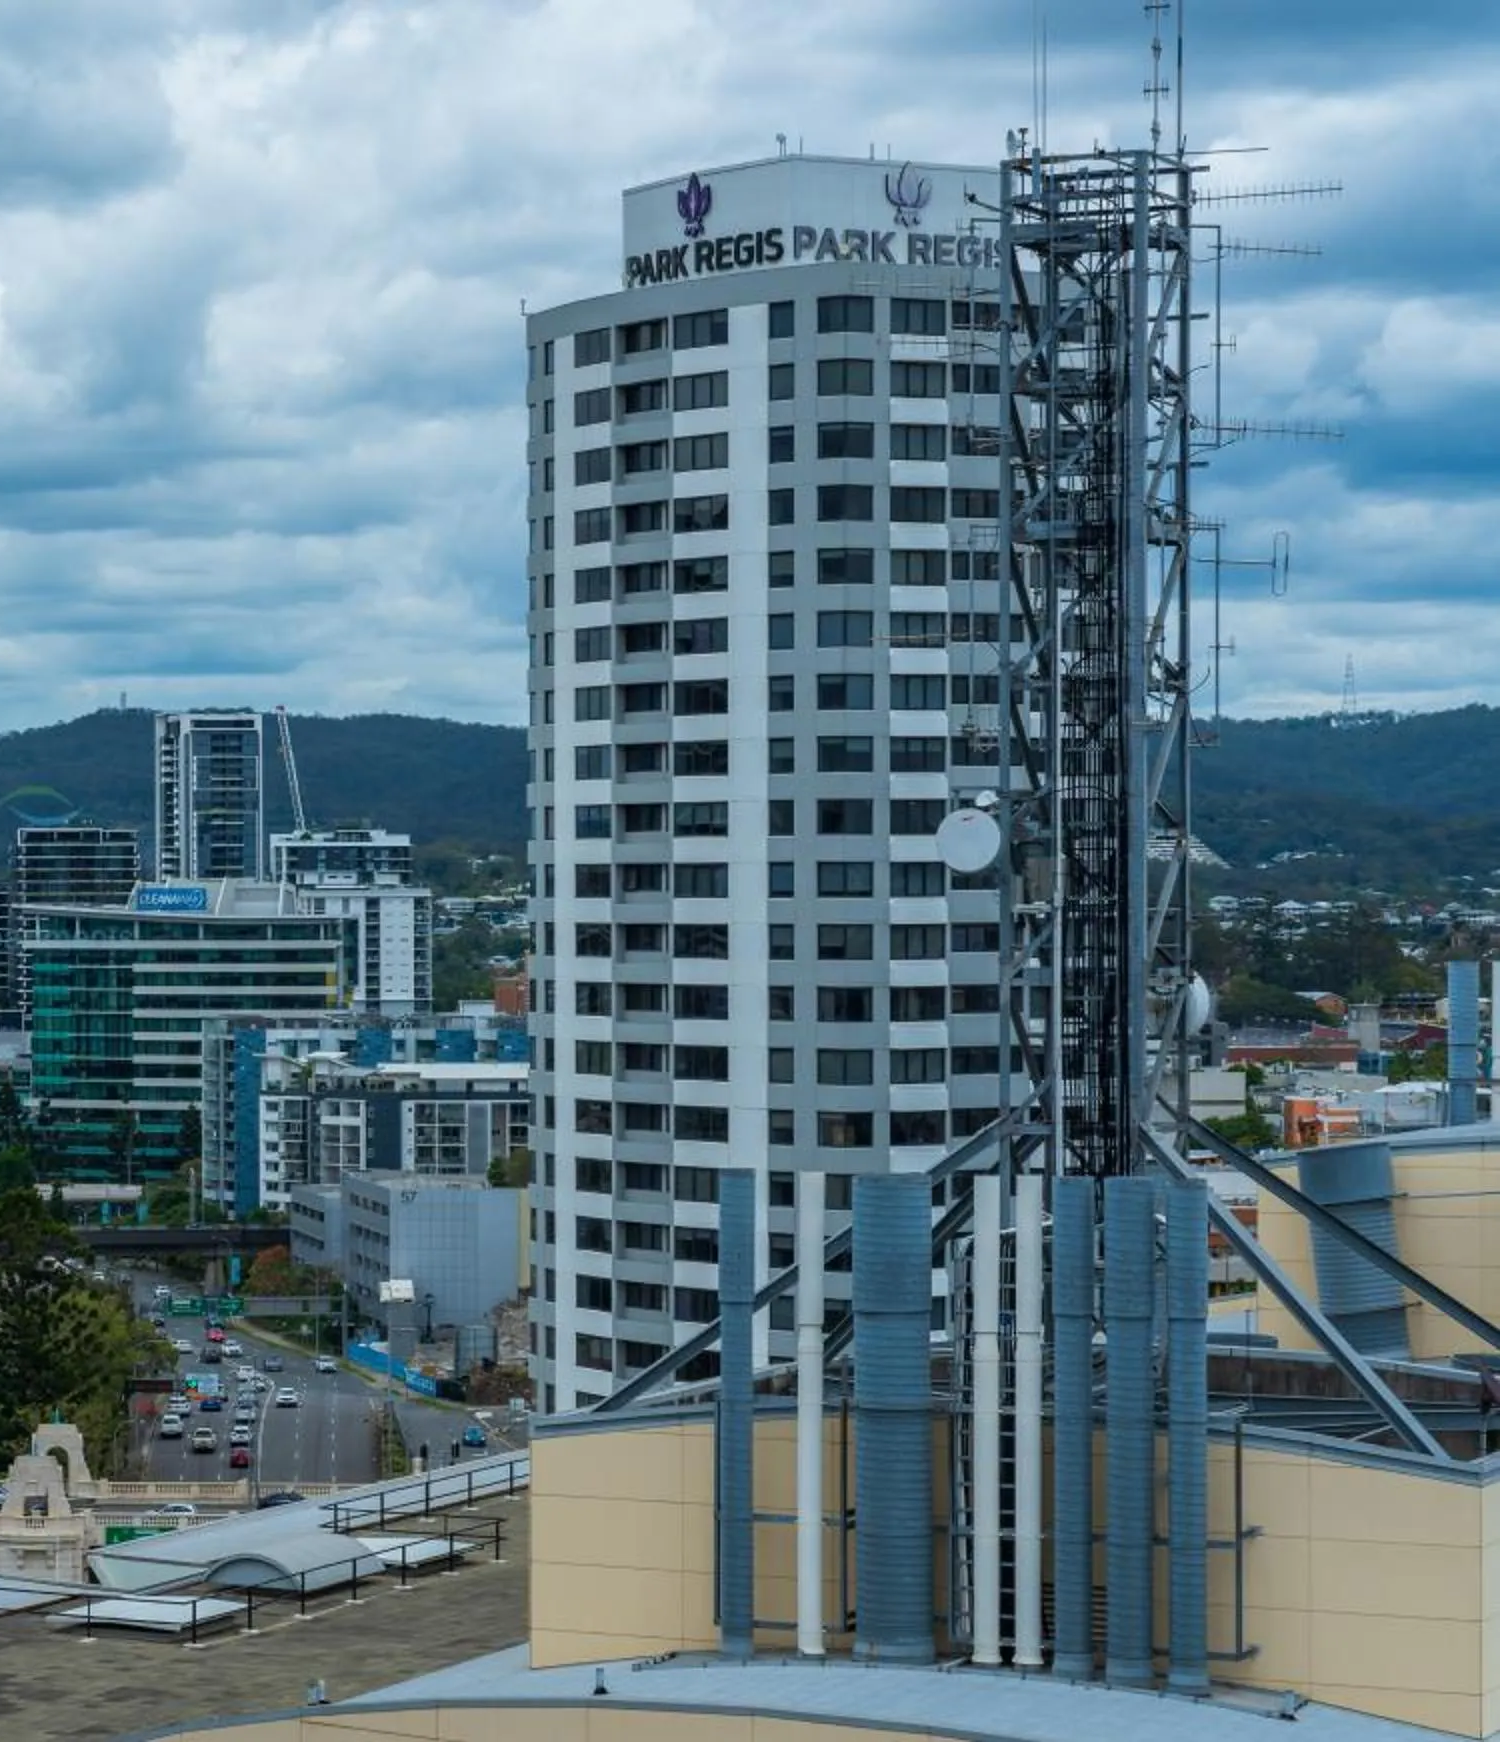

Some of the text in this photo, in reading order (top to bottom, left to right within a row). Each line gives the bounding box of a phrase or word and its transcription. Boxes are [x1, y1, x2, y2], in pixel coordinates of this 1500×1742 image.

[625, 227, 785, 288] PARK REGIS
[793, 225, 897, 264] PARK
